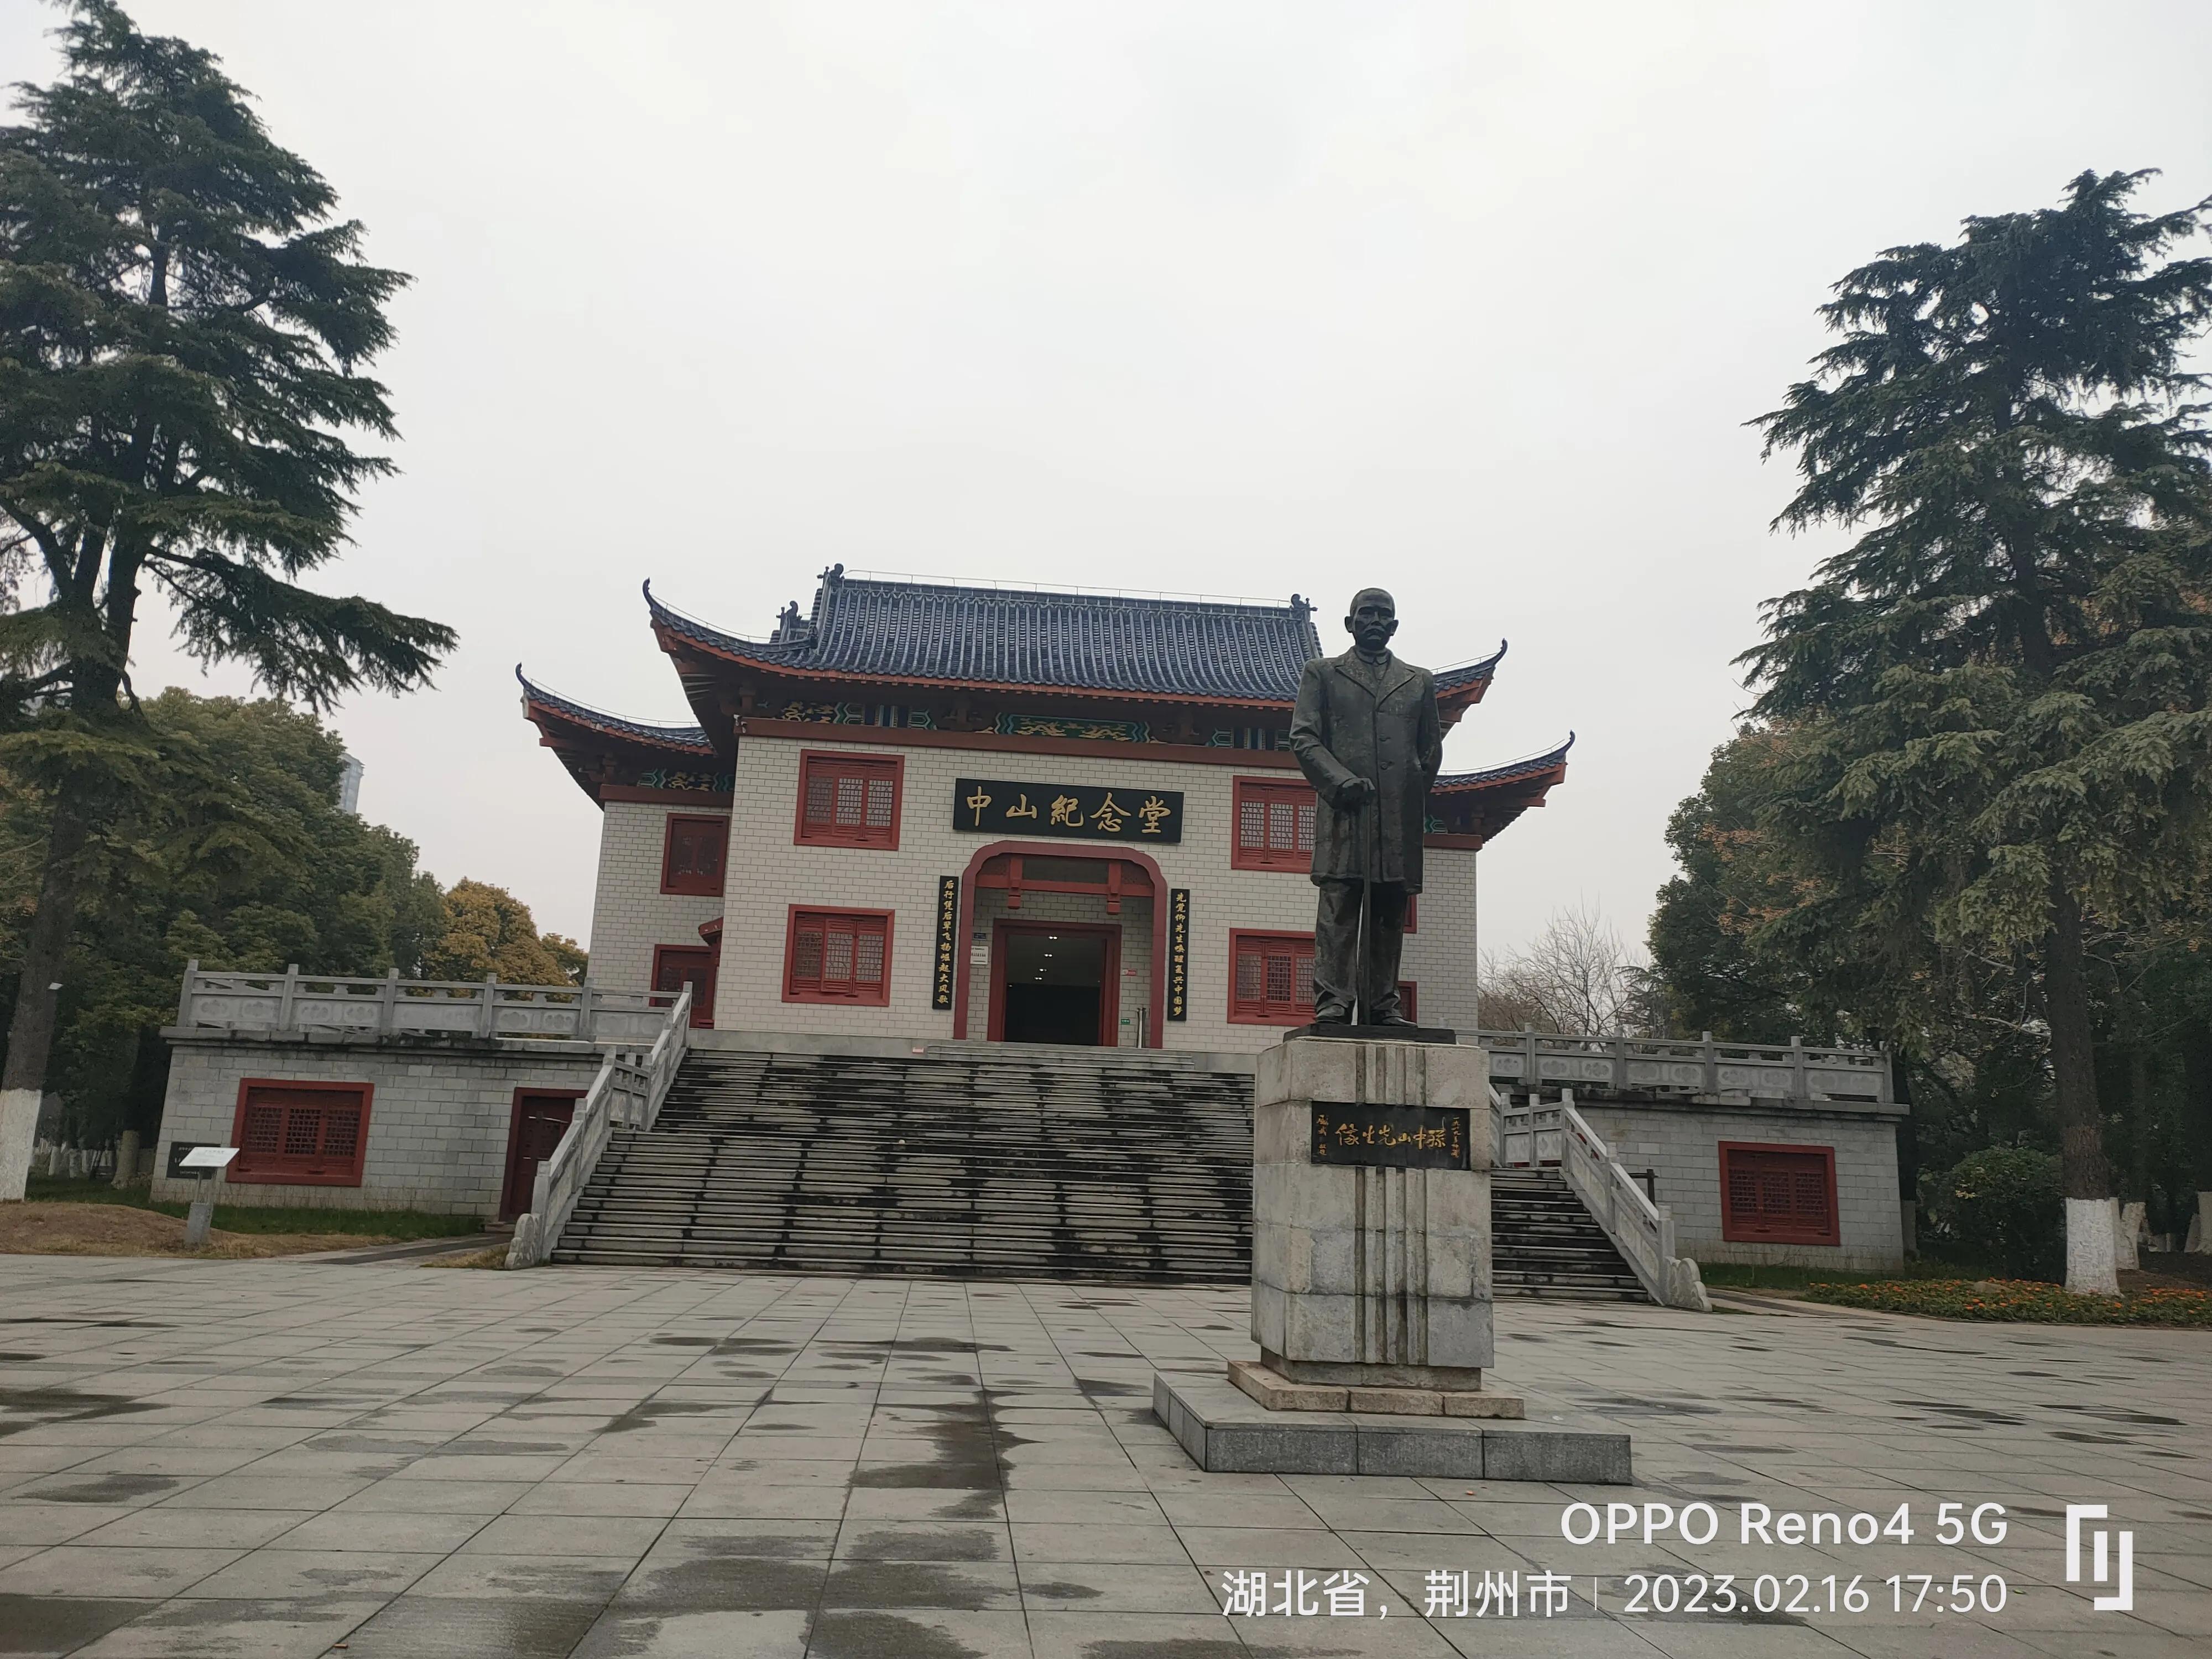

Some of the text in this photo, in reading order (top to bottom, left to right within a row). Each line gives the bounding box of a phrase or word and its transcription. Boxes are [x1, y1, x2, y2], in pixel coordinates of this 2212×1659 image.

[967, 786, 1171, 834] 中山紀念堂
